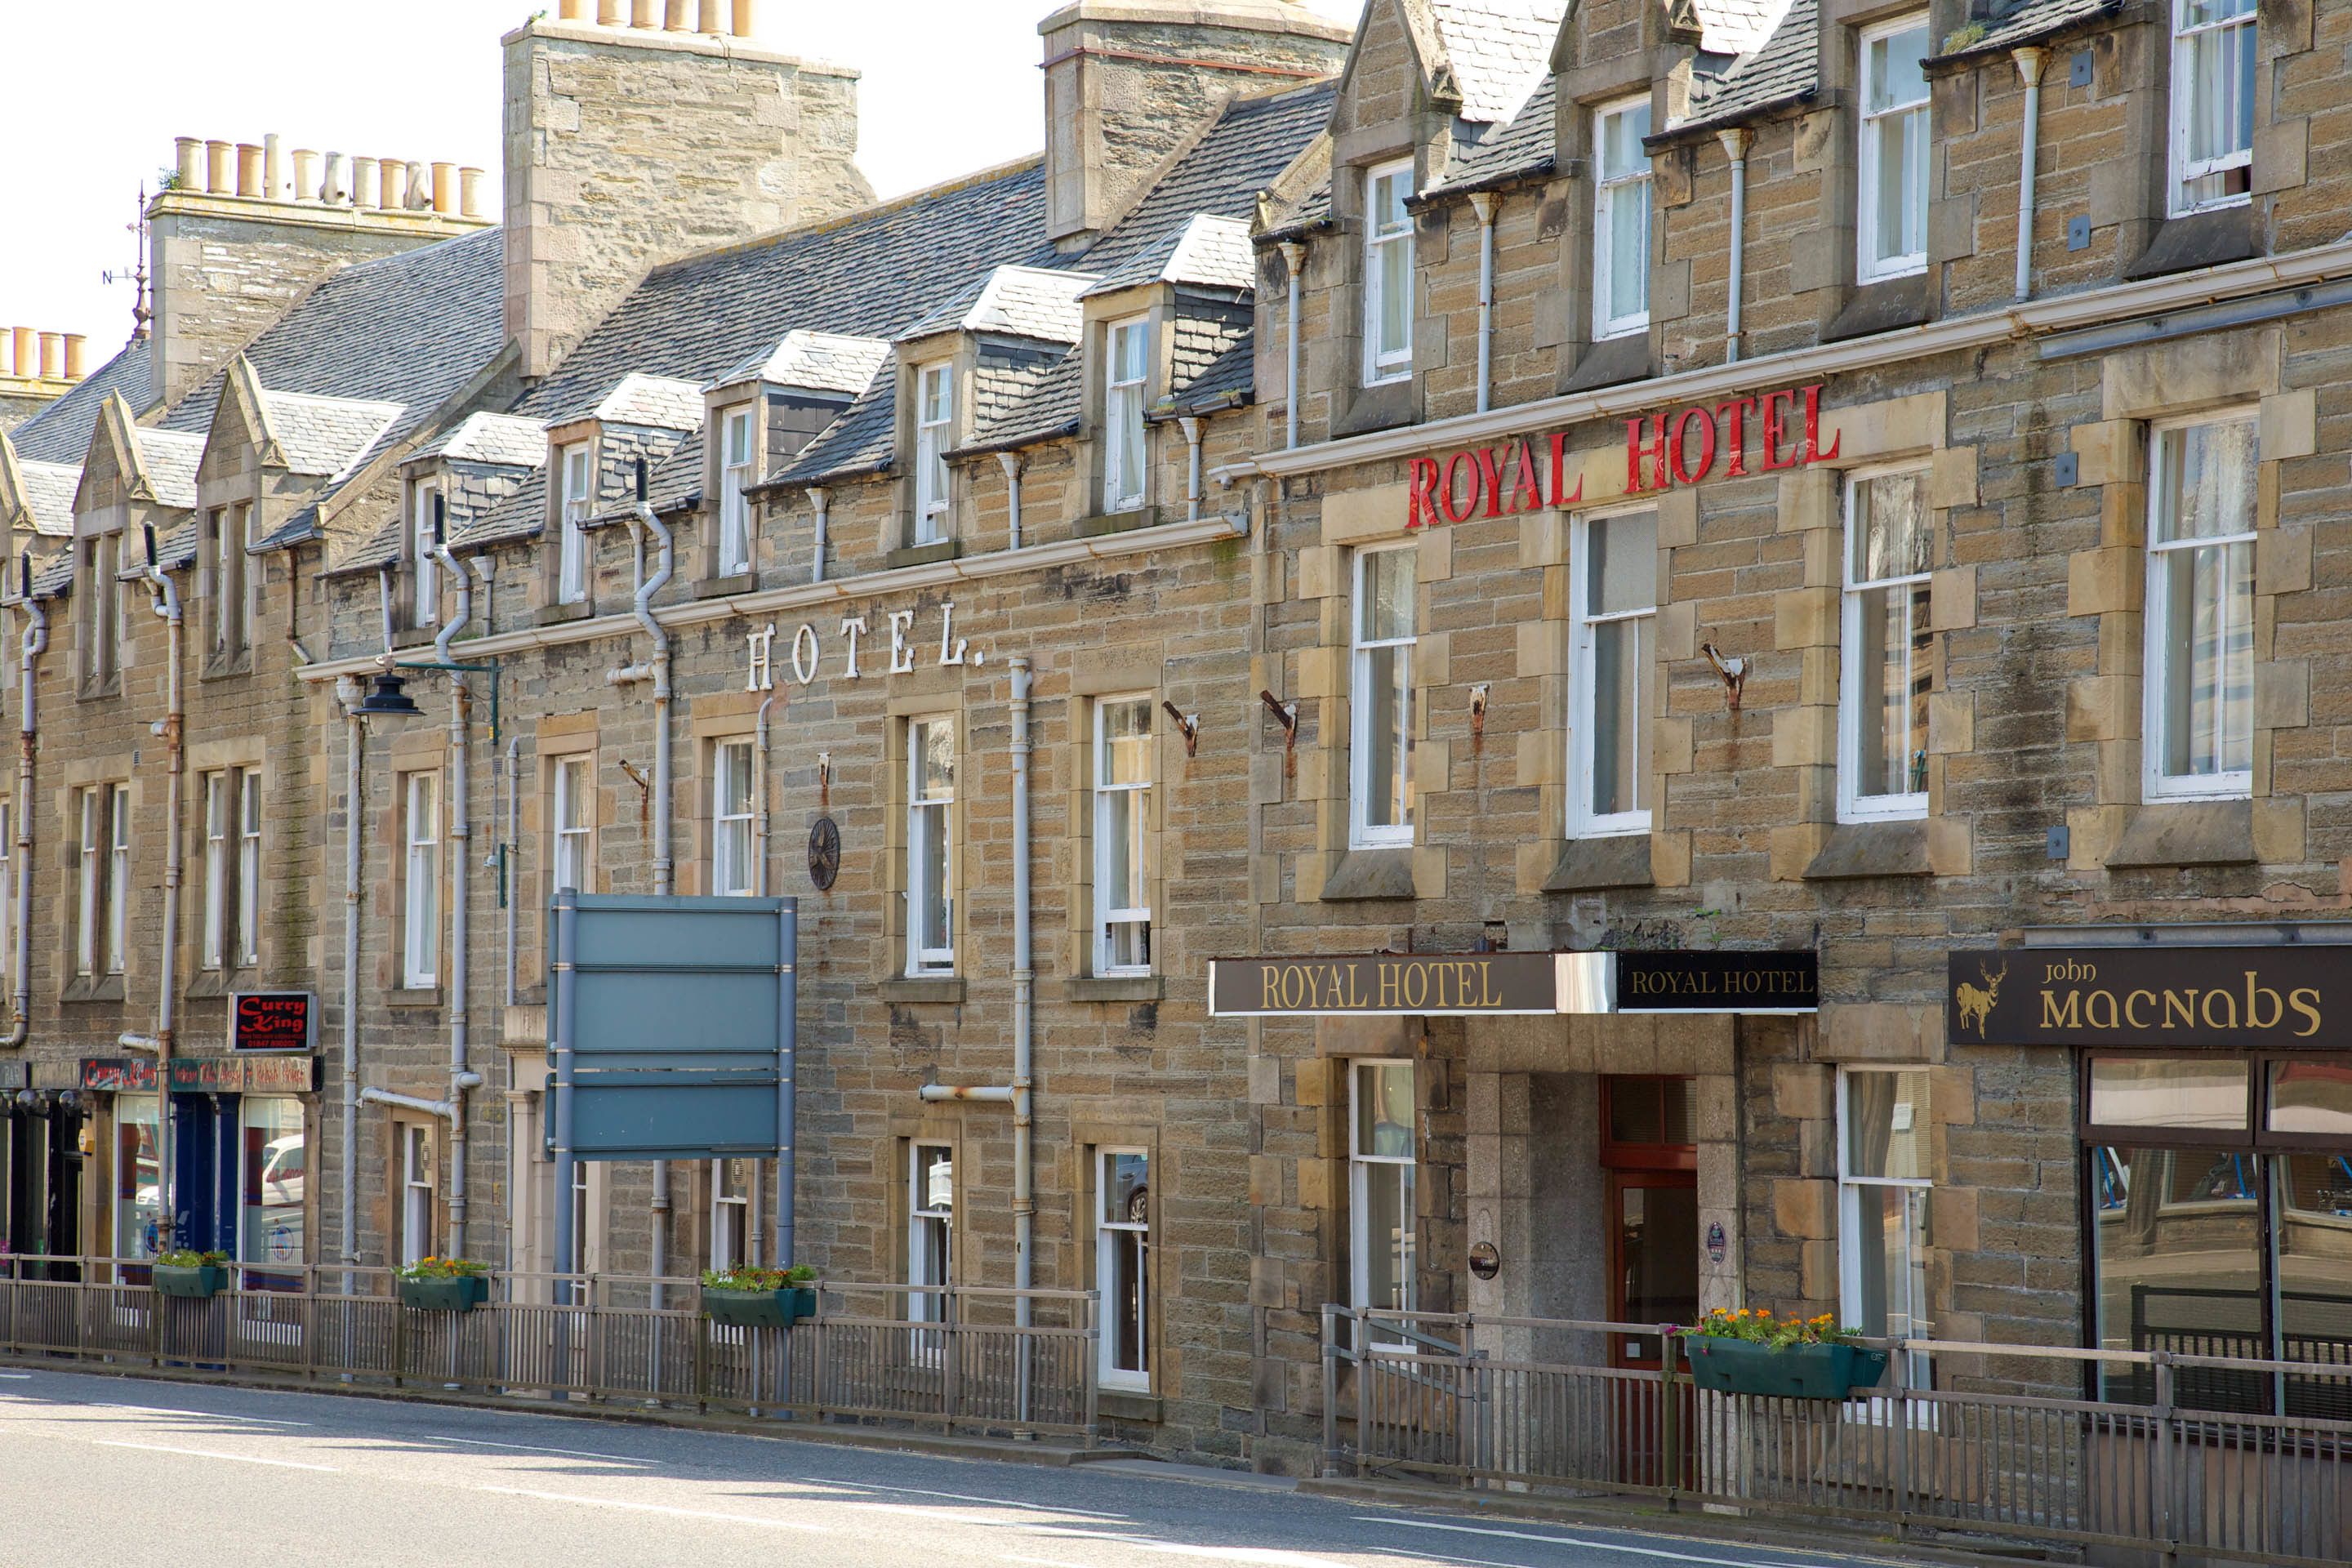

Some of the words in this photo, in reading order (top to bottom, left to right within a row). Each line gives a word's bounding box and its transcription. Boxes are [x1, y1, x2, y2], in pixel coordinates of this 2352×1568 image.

[1405, 431, 1584, 528] ROYAL
[1623, 383, 1841, 494] HOTEL
[1631, 970, 1717, 995] ROYAL
[1723, 970, 1814, 994] HOTEL
[2042, 958, 2097, 984] John
[1260, 964, 1368, 1009] ROYAL
[1377, 961, 1503, 1008] HOTEL
[239, 996, 306, 1016] Curry
[2039, 970, 2322, 1037] MacNabs
[240, 1015, 304, 1033] King
[85, 1060, 121, 1087] Curry
[122, 1062, 158, 1087] King
